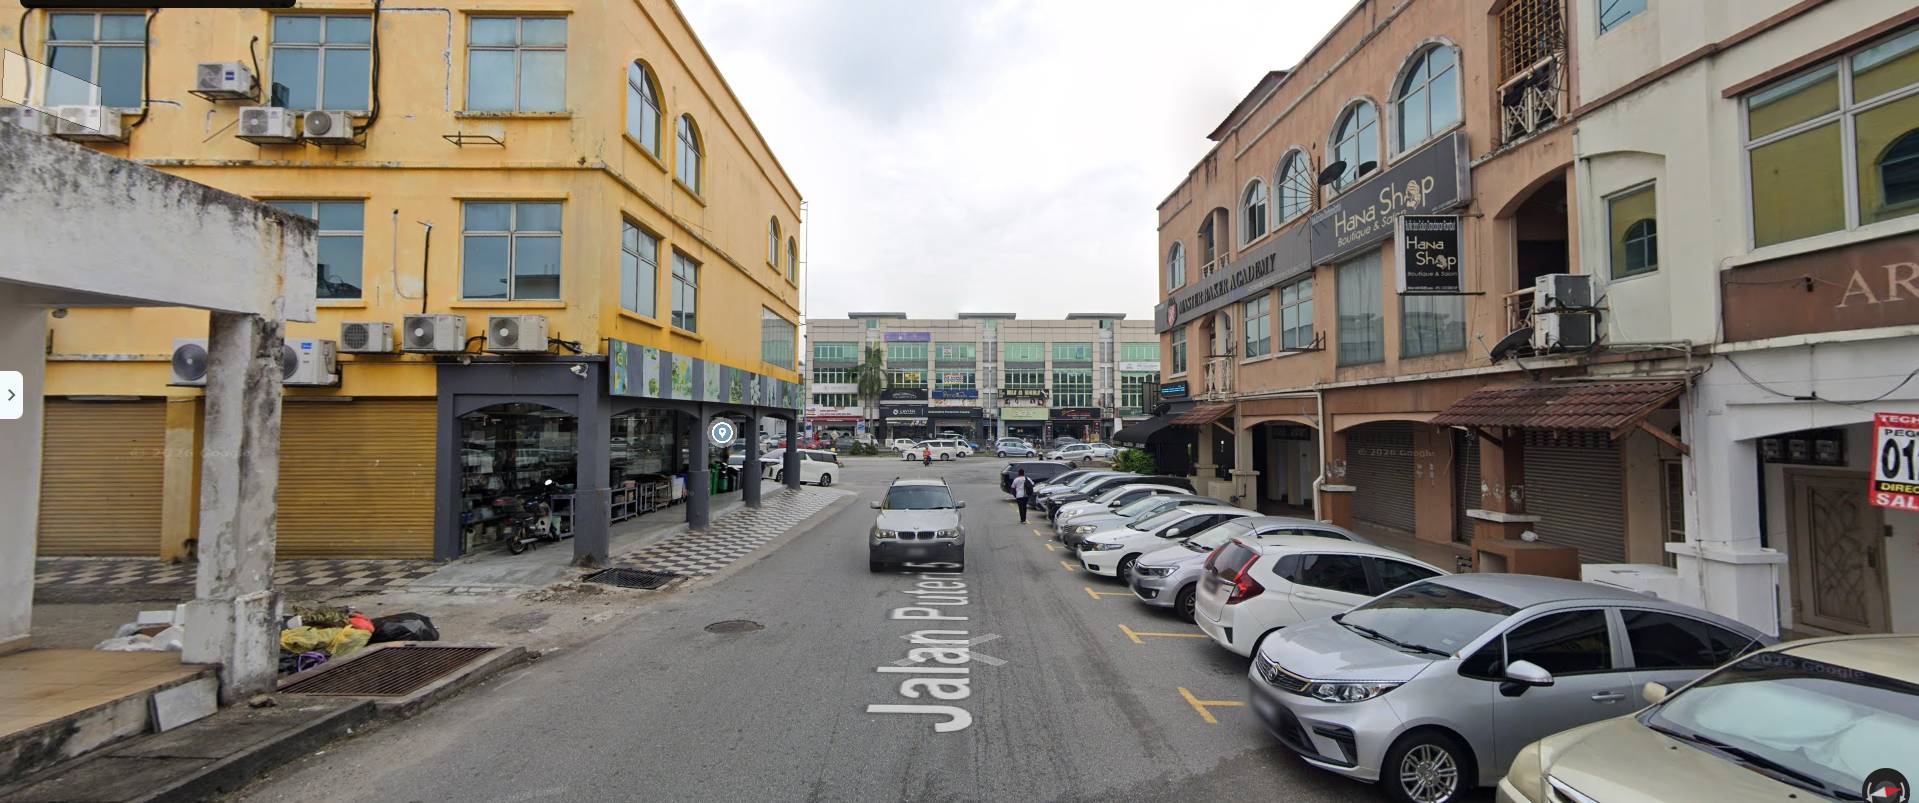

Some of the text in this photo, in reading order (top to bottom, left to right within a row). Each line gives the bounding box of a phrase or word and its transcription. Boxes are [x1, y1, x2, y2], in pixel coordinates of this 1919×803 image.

[1334, 204, 1376, 238] Hana
[1337, 223, 1371, 248] Boutique
[1373, 220, 1380, 231] &
[1406, 235, 1444, 250] Hana
[1230, 252, 1277, 291] ACADEMY
[1881, 438, 1919, 481] 01
